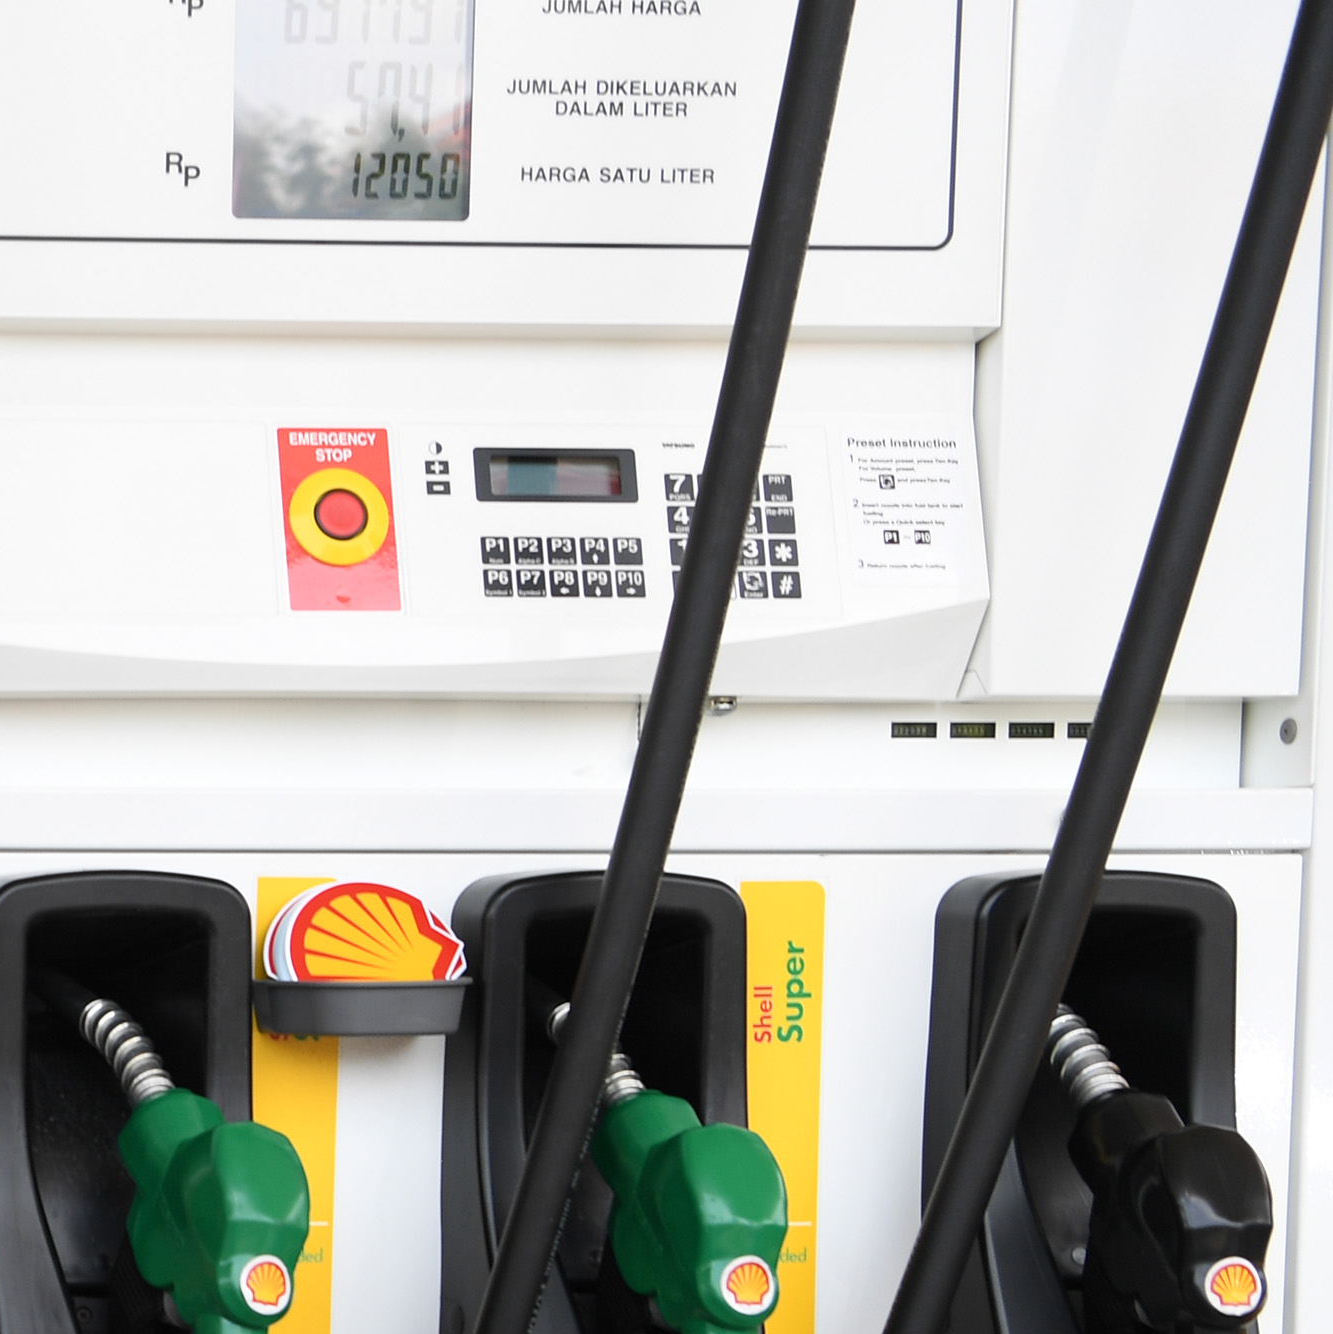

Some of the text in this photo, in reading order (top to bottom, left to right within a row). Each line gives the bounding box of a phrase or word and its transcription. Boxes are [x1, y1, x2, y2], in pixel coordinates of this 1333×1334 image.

[542, 0, 702, 15] JUMLAH HARGA
[507, 79, 737, 97] JUMLAH DIKELUARKAN
[555, 101, 688, 118] DALAM LITER
[352, 153, 461, 200] 12050
[521, 167, 715, 184] HARGA SATU LITER
[289, 432, 376, 446] EMERGENCY
[847, 438, 957, 449] Preset Instruction
[315, 448, 353, 463] STOP
[669, 475, 686, 493] 7
[768, 476, 787, 485] PRT
[673, 506, 690, 525] 4
[885, 531, 931, 543] P1 P10
[485, 538, 504, 552] P1
[518, 538, 539, 552] P2
[551, 538, 572, 553] P3
[584, 538, 605, 553] P4
[617, 539, 638, 553] P5
[742, 540, 759, 558] 3
[488, 570, 509, 585] P6
[520, 570, 541, 585] P7
[553, 570, 575, 585] P8
[587, 571, 608, 585] P9
[618, 571, 643, 586] P10
[776, 940, 812, 1043] Super
[753, 986, 773, 1043] Shell
